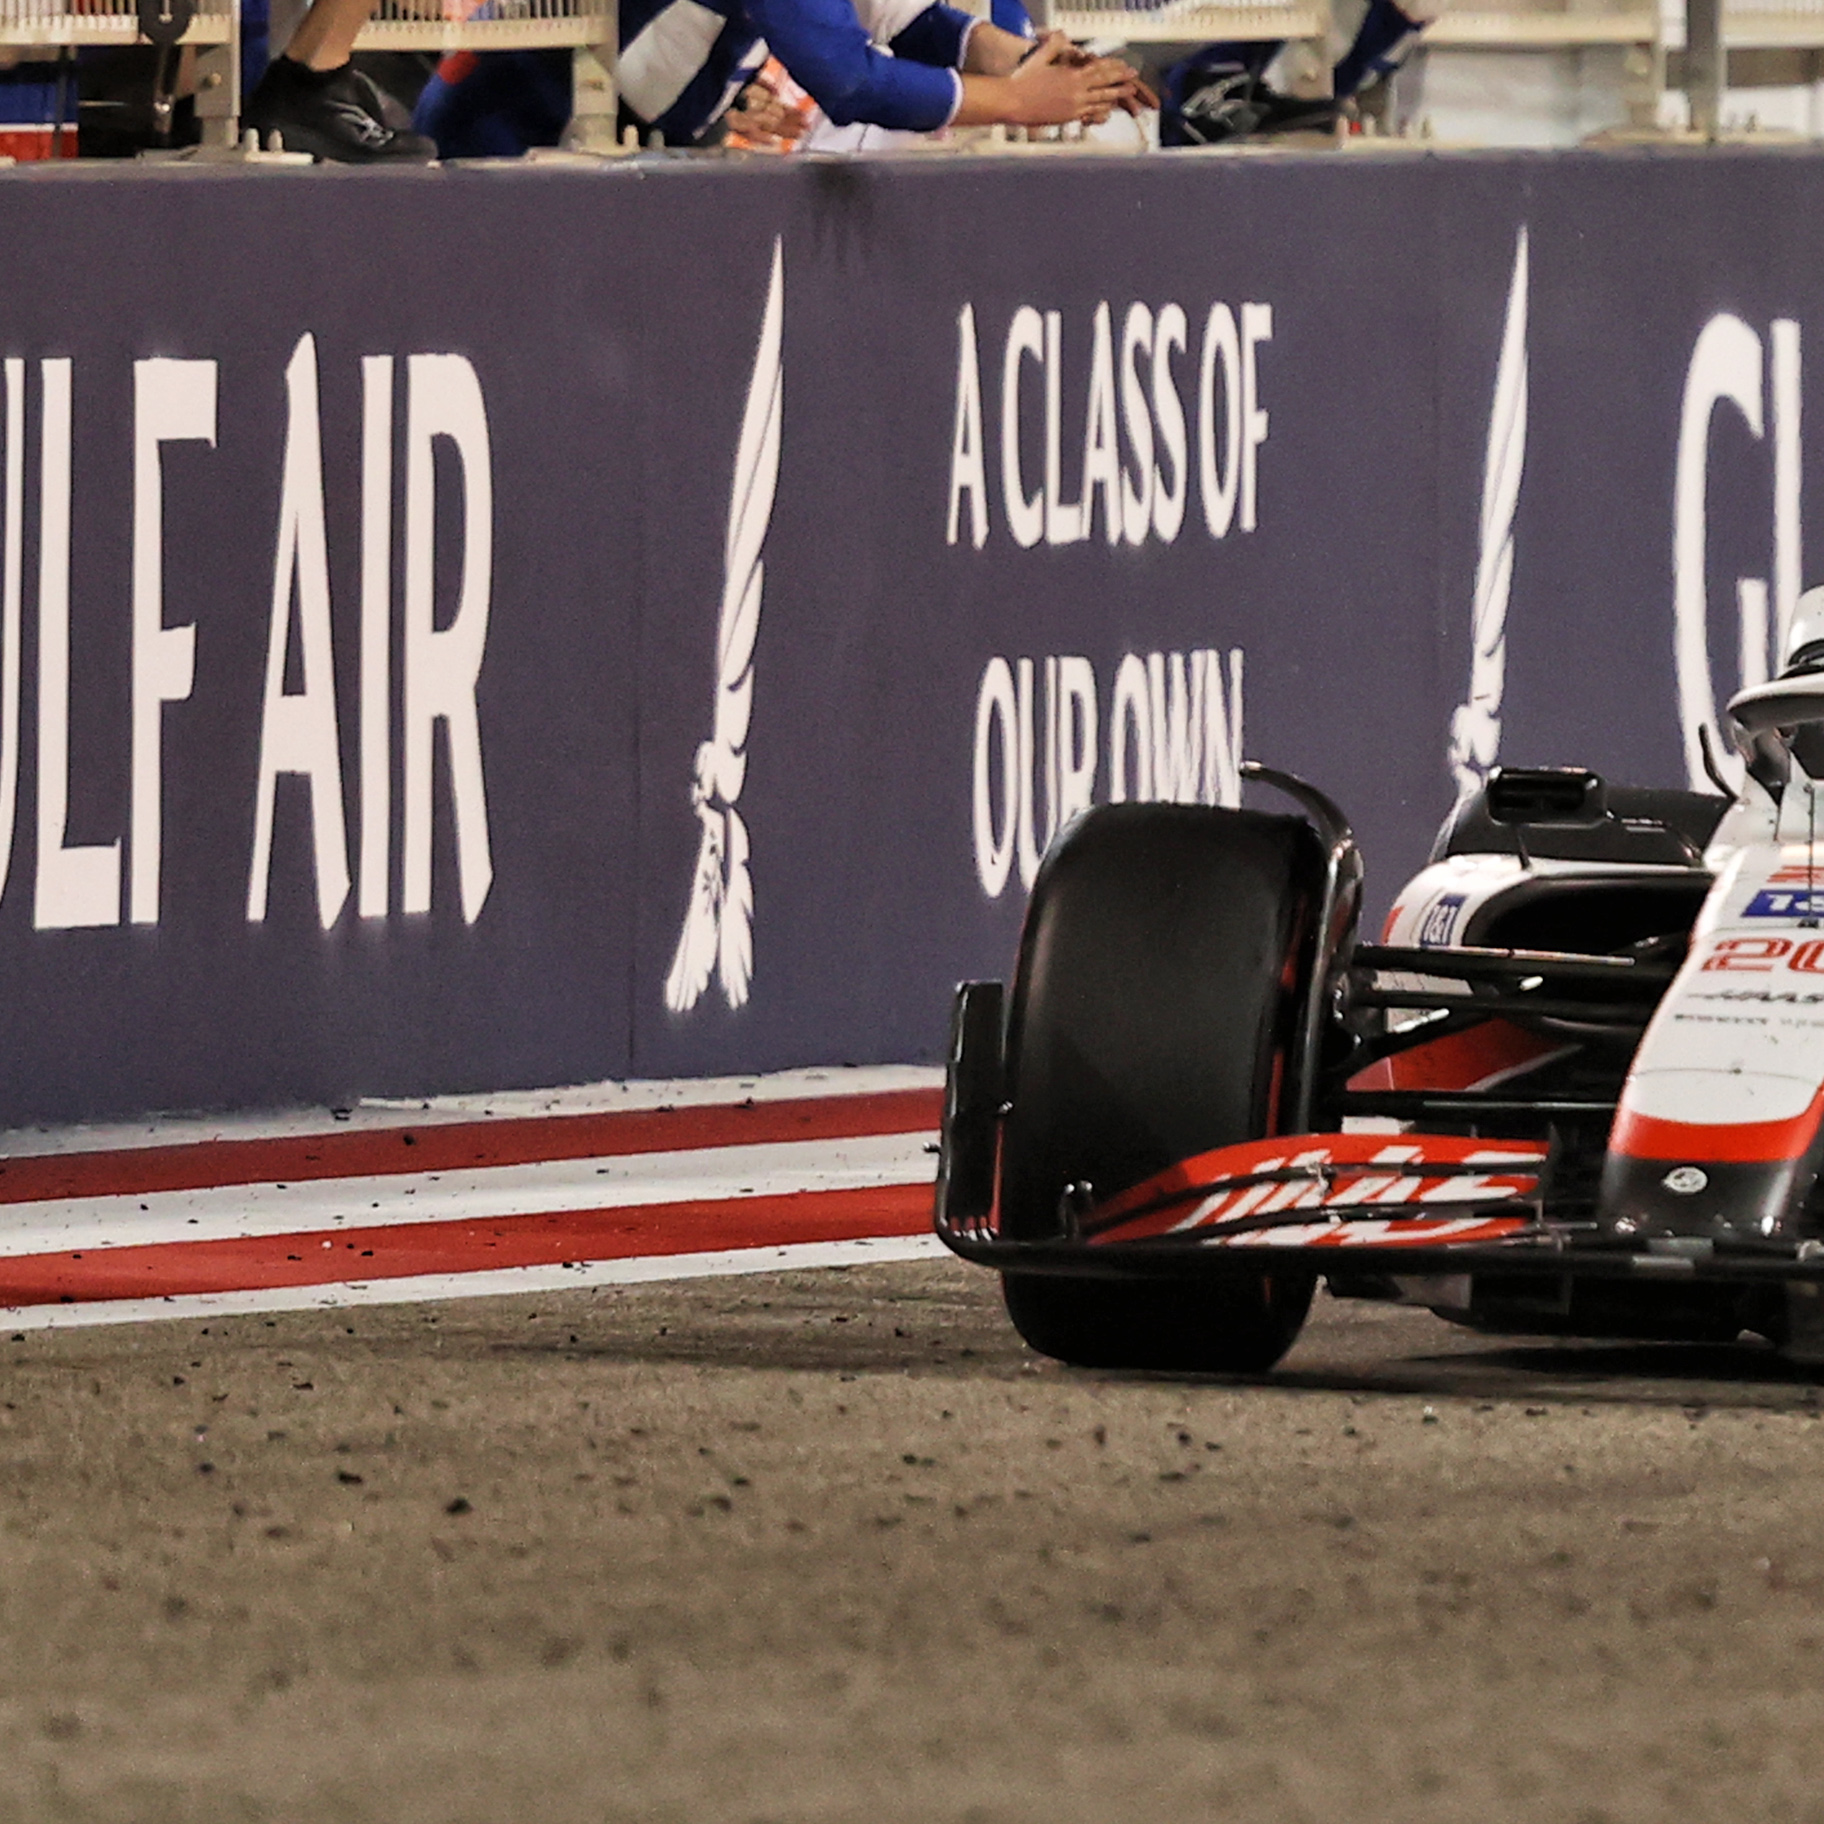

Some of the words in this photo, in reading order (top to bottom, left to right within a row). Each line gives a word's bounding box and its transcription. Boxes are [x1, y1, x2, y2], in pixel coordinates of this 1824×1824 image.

[946, 302, 990, 550] A
[1001, 299, 1188, 548] CLASS
[1198, 301, 1273, 539] OF
[246, 331, 495, 931] AIR
[973, 655, 1098, 899] OUR
